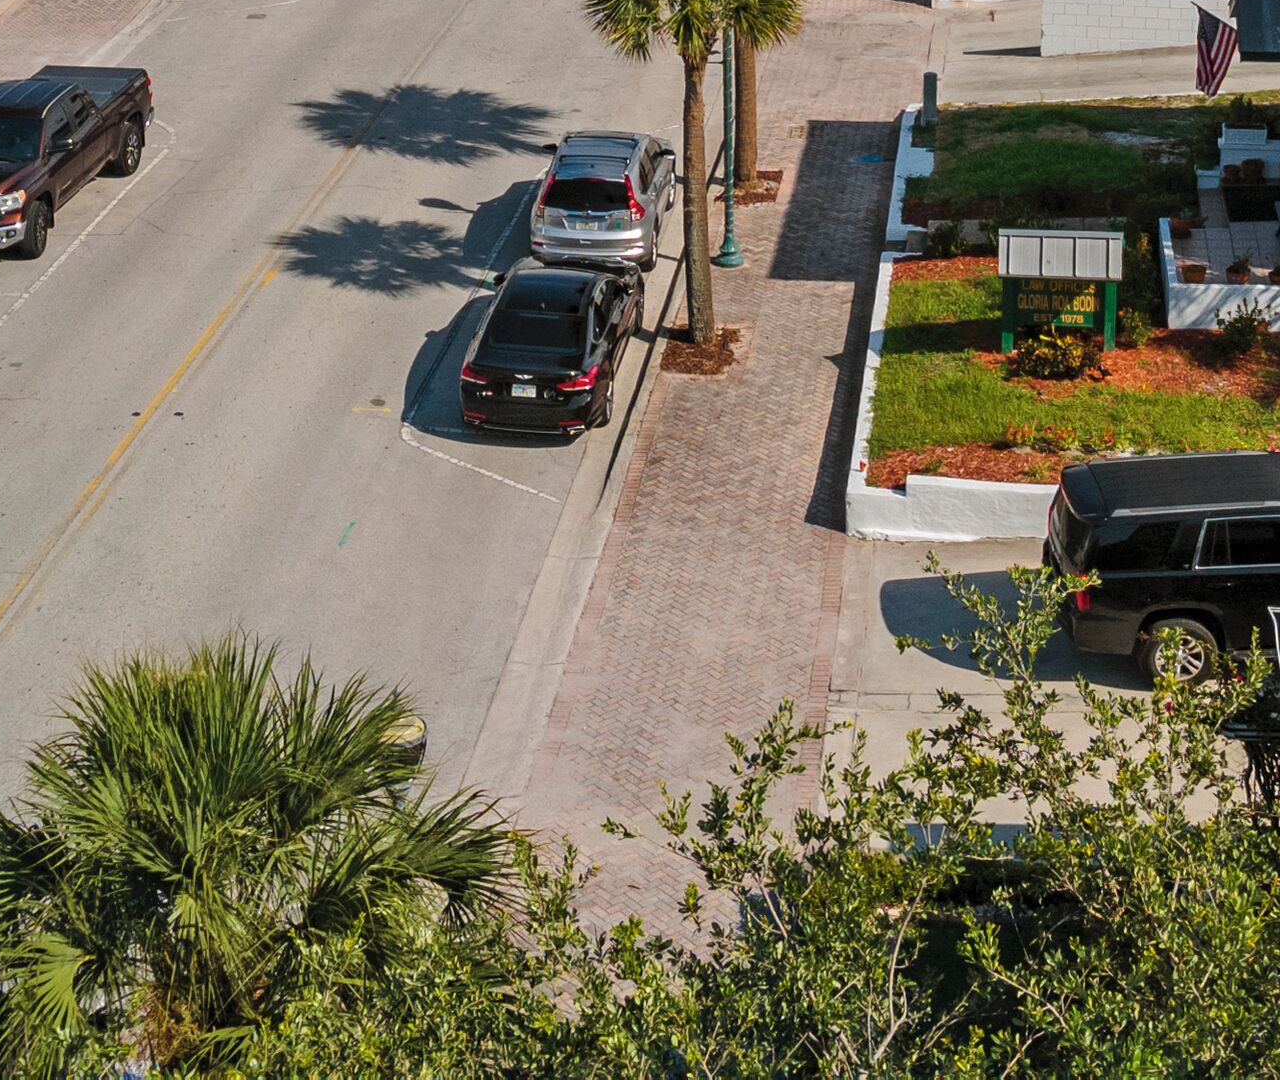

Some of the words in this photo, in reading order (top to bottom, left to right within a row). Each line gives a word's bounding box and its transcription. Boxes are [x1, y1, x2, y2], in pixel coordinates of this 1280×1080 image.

[1022, 280, 1044, 291] LAW
[1049, 280, 1096, 293] OFFICES
[1017, 294, 1049, 310] GLORIA
[1073, 295, 1100, 312] BODIN
